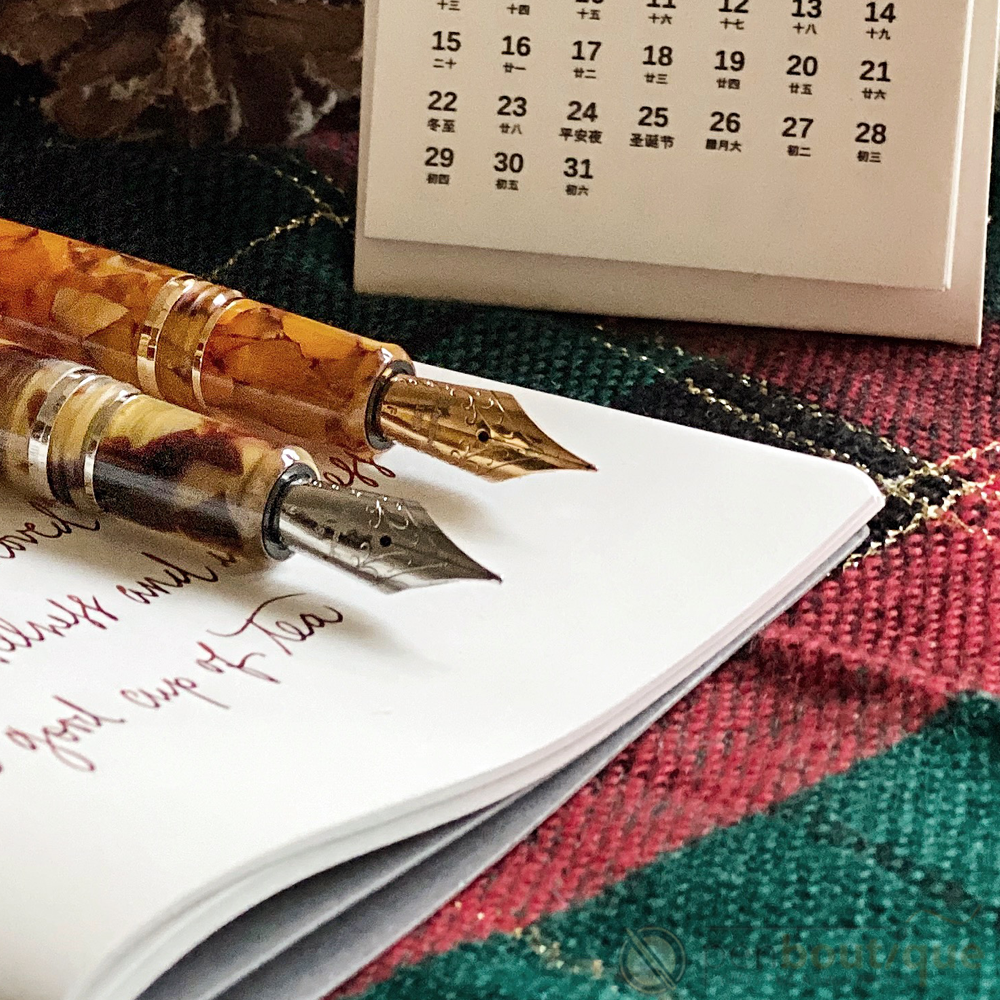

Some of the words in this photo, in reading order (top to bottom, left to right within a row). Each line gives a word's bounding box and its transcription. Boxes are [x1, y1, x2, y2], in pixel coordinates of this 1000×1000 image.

[437, 0, 460, 11] 十三
[507, 4, 530, 15] 十四
[577, 8, 600, 20] 十五
[648, 13, 672, 24] 十六
[720, 18, 744, 30] 十七
[793, 22, 817, 35] 十八
[866, 28, 891, 40] 十九
[865, 2, 896, 23] 14
[432, 31, 461, 52] 15
[501, 35, 531, 56] 16
[571, 40, 602, 61] 17
[642, 45, 673, 66] 18
[714, 50, 745, 72] 19
[786, 55, 818, 76] 20
[859, 60, 891, 82] 21
[433, 58, 457, 69] 二十
[427, 91, 457, 112] 22
[497, 95, 527, 117] 23
[567, 101, 598, 122] 24
[638, 106, 668, 127] 25
[709, 111, 740, 133] 26
[782, 117, 814, 138] 27
[855, 122, 886, 144] 28
[427, 118, 455, 133] 冬至
[559, 127, 603, 144] 平安夜
[629, 133, 675, 149] 圣诞节
[424, 147, 454, 168] 29
[493, 152, 523, 173] 30
[563, 157, 593, 179] 31
[116, 552, 218, 605] and
[5, 695, 126, 772] good
[121, 675, 230, 710] cup
[196, 640, 281, 684] of
